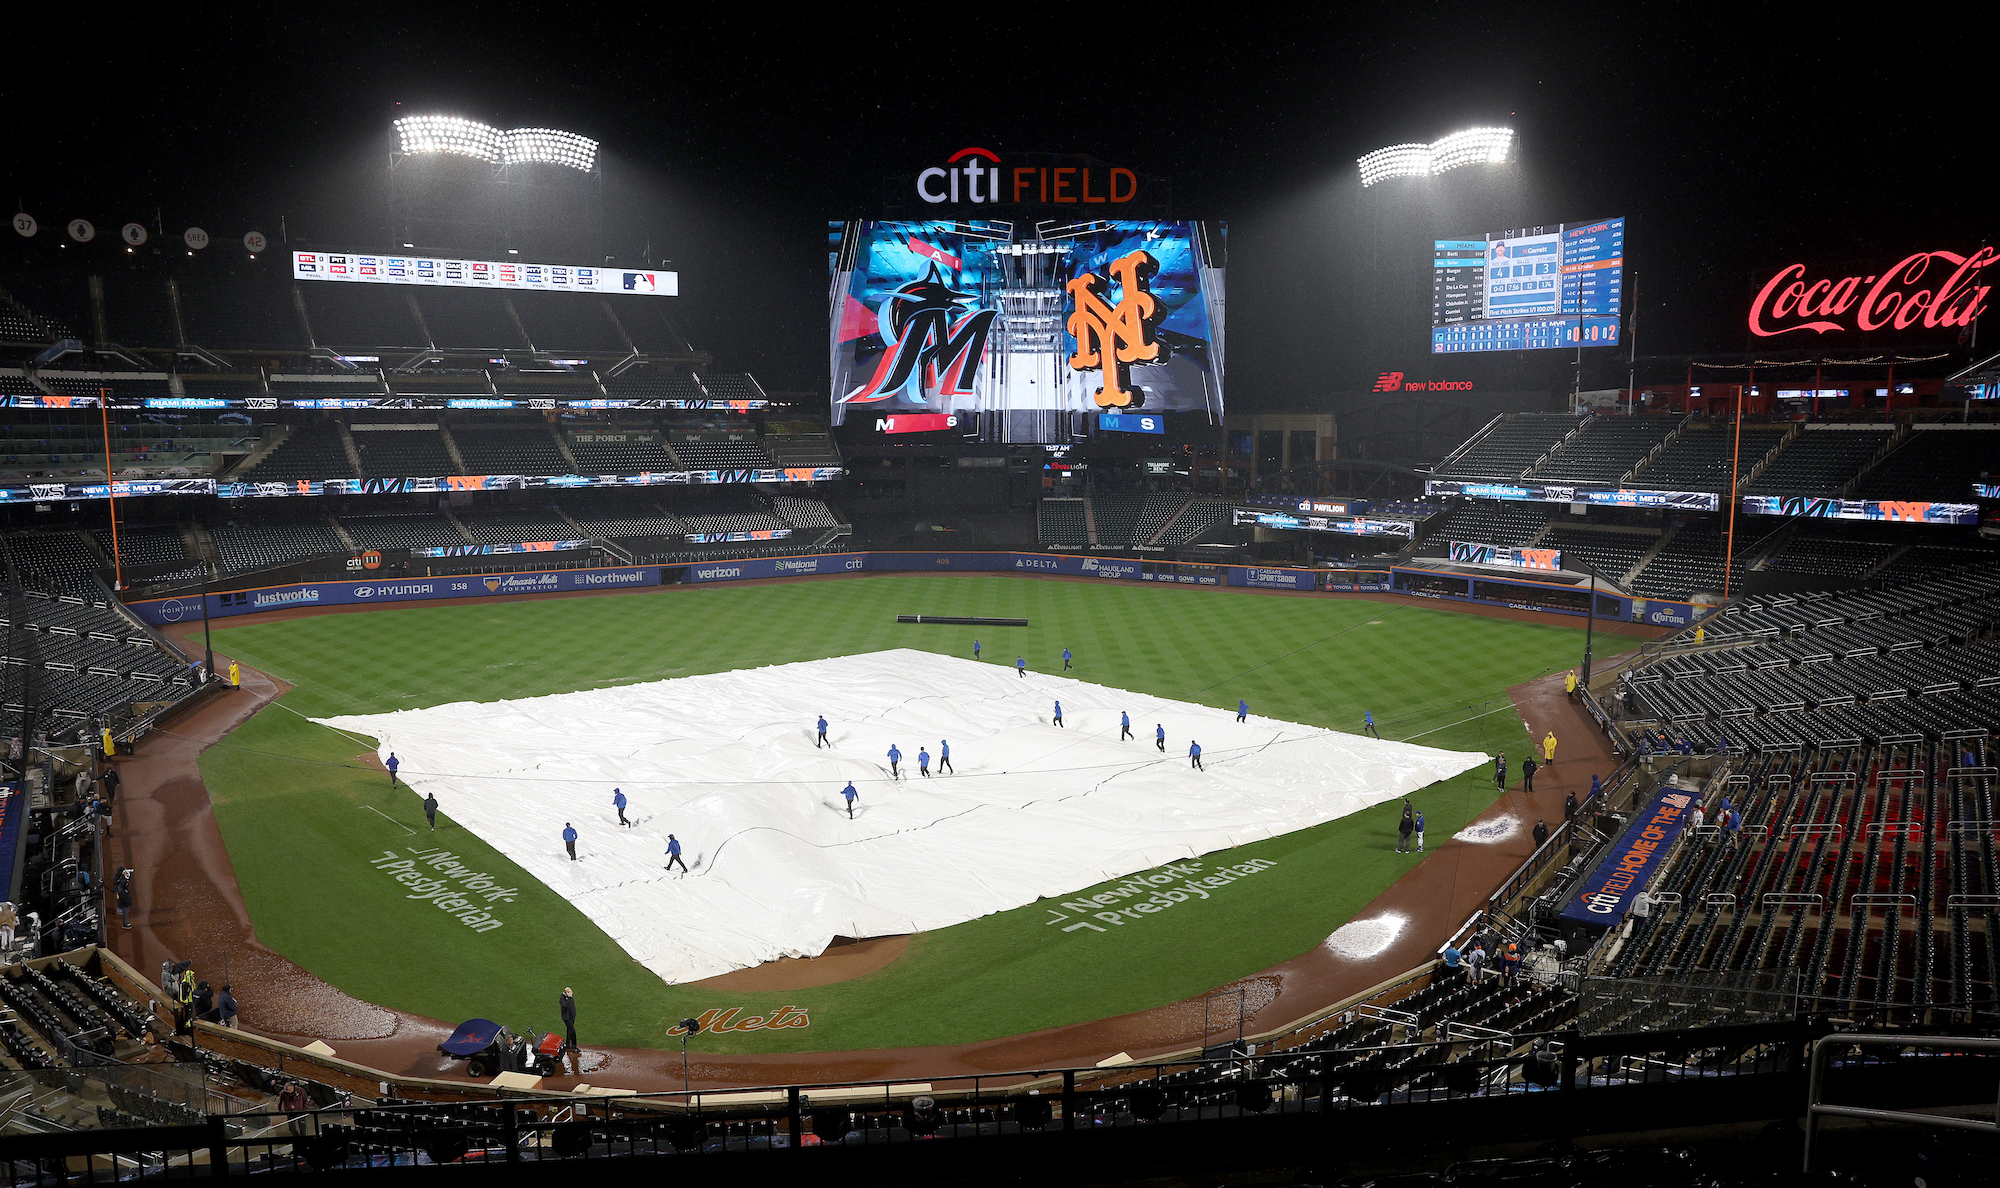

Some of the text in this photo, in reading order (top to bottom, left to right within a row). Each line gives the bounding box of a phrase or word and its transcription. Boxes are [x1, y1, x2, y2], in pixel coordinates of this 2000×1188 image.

[918, 156, 1137, 203] citi FIELD
[18, 220, 32, 230] 37
[1570, 230, 1585, 238] NEW
[1587, 223, 1608, 234] YORK
[188, 234, 206, 242] SHEA
[247, 237, 262, 247] 42
[1497, 268, 1503, 277] 4
[1521, 266, 1524, 275] 1
[1543, 264, 1549, 273] 3
[1749, 247, 2000, 337] Coca-Cola
[1567, 325, 1616, 342] B 0 S 0 2
[1405, 380, 1473, 391] new balance
[245, 398, 278, 409] VS
[528, 399, 555, 410] VS
[595, 434, 627, 442] PORCH
[30, 484, 66, 499] VS
[1491, 488, 1527, 496] MARLINS
[1544, 487, 1576, 501] VS
[1589, 492, 1610, 501] NEW
[1611, 493, 1637, 502] YORK
[1639, 495, 1666, 503] METS
[1299, 501, 1345, 513] citi PAVILION
[347, 558, 361, 566] citi
[784, 559, 818, 569] National
[845, 558, 862, 569] citi
[1026, 559, 1057, 568] DELTA
[1082, 558, 1099, 570] HG
[698, 567, 740, 579] verizon
[1100, 565, 1134, 573] HAUGLAND
[502, 574, 558, 587] Amazin' Mets
[585, 571, 643, 585] Northwell
[1260, 574, 1296, 583] SPORTSBOOK
[378, 584, 433, 596] HYUNDAI
[451, 582, 468, 591] 358
[253, 588, 319, 606] Justworks
[1411, 591, 1441, 599] CADILLAC
[158, 605, 201, 615] 1POINTFIVE
[1509, 603, 1542, 612] CADILLAC
[1652, 612, 1684, 624] Corona
[1581, 806, 1683, 914] citi FIELD HOME OF THE
[376, 859, 503, 933] Presbyterian
[1093, 858, 1278, 926] Presbyterian
[666, 1005, 810, 1036] Mets
